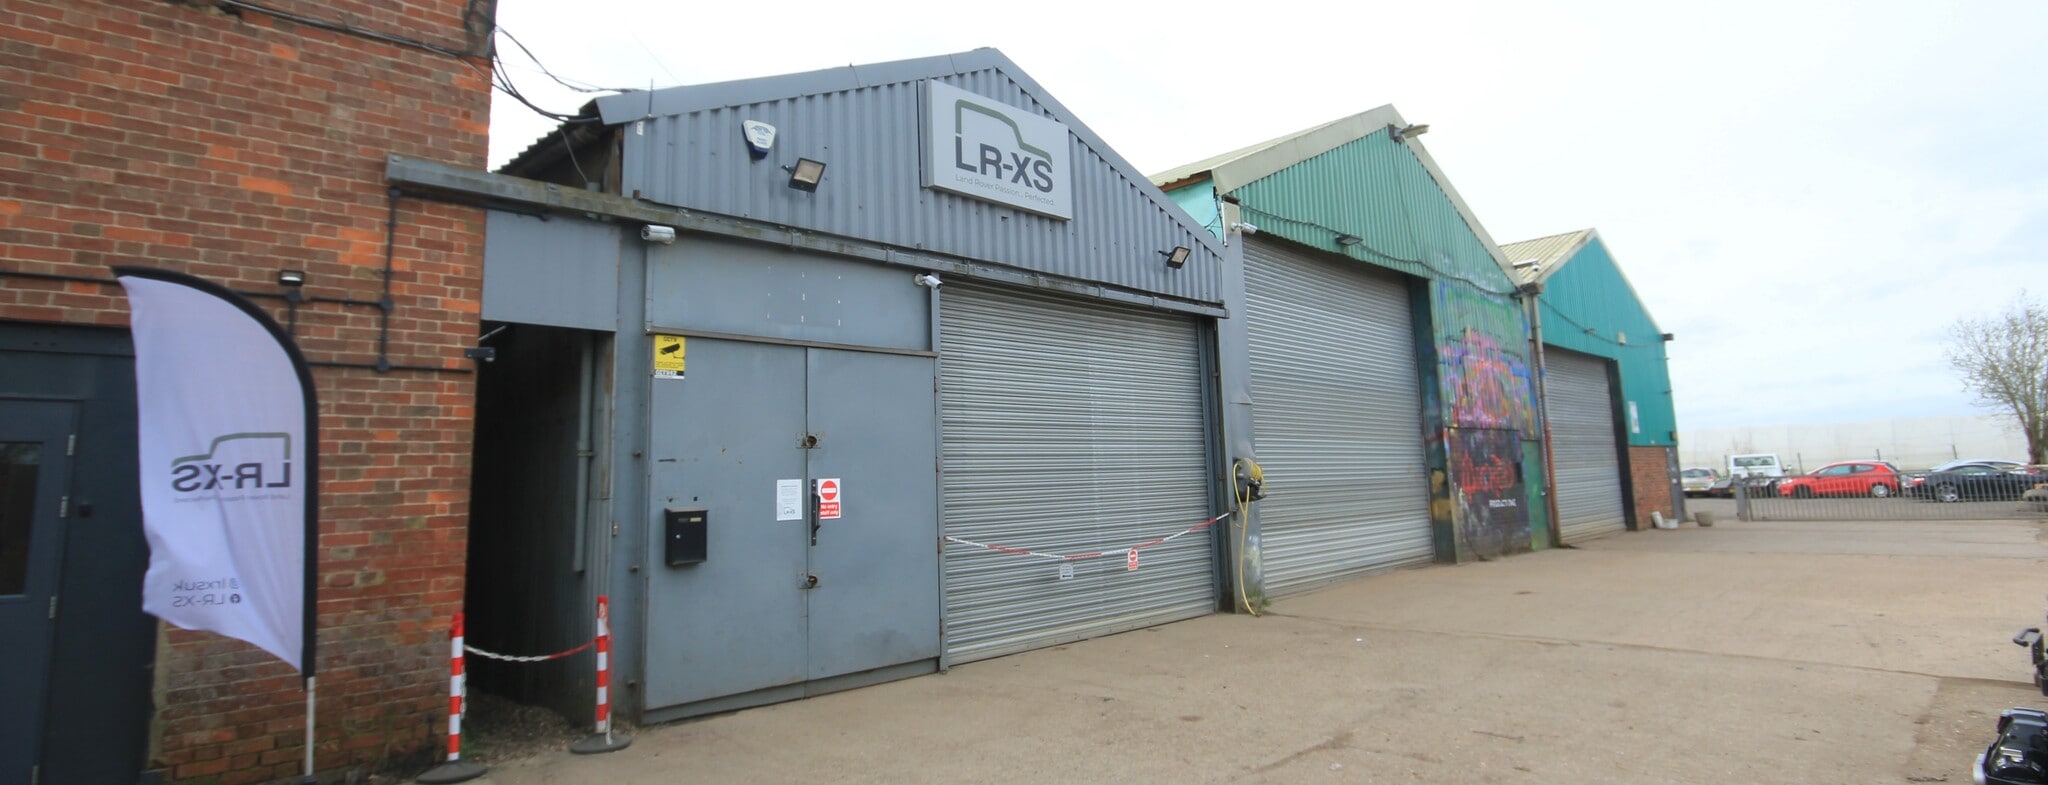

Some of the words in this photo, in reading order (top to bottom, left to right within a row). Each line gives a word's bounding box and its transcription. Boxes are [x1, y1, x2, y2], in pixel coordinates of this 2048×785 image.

[955, 136, 1053, 193] LR-XS
[955, 175, 973, 185] Land
[975, 179, 994, 189] Rover
